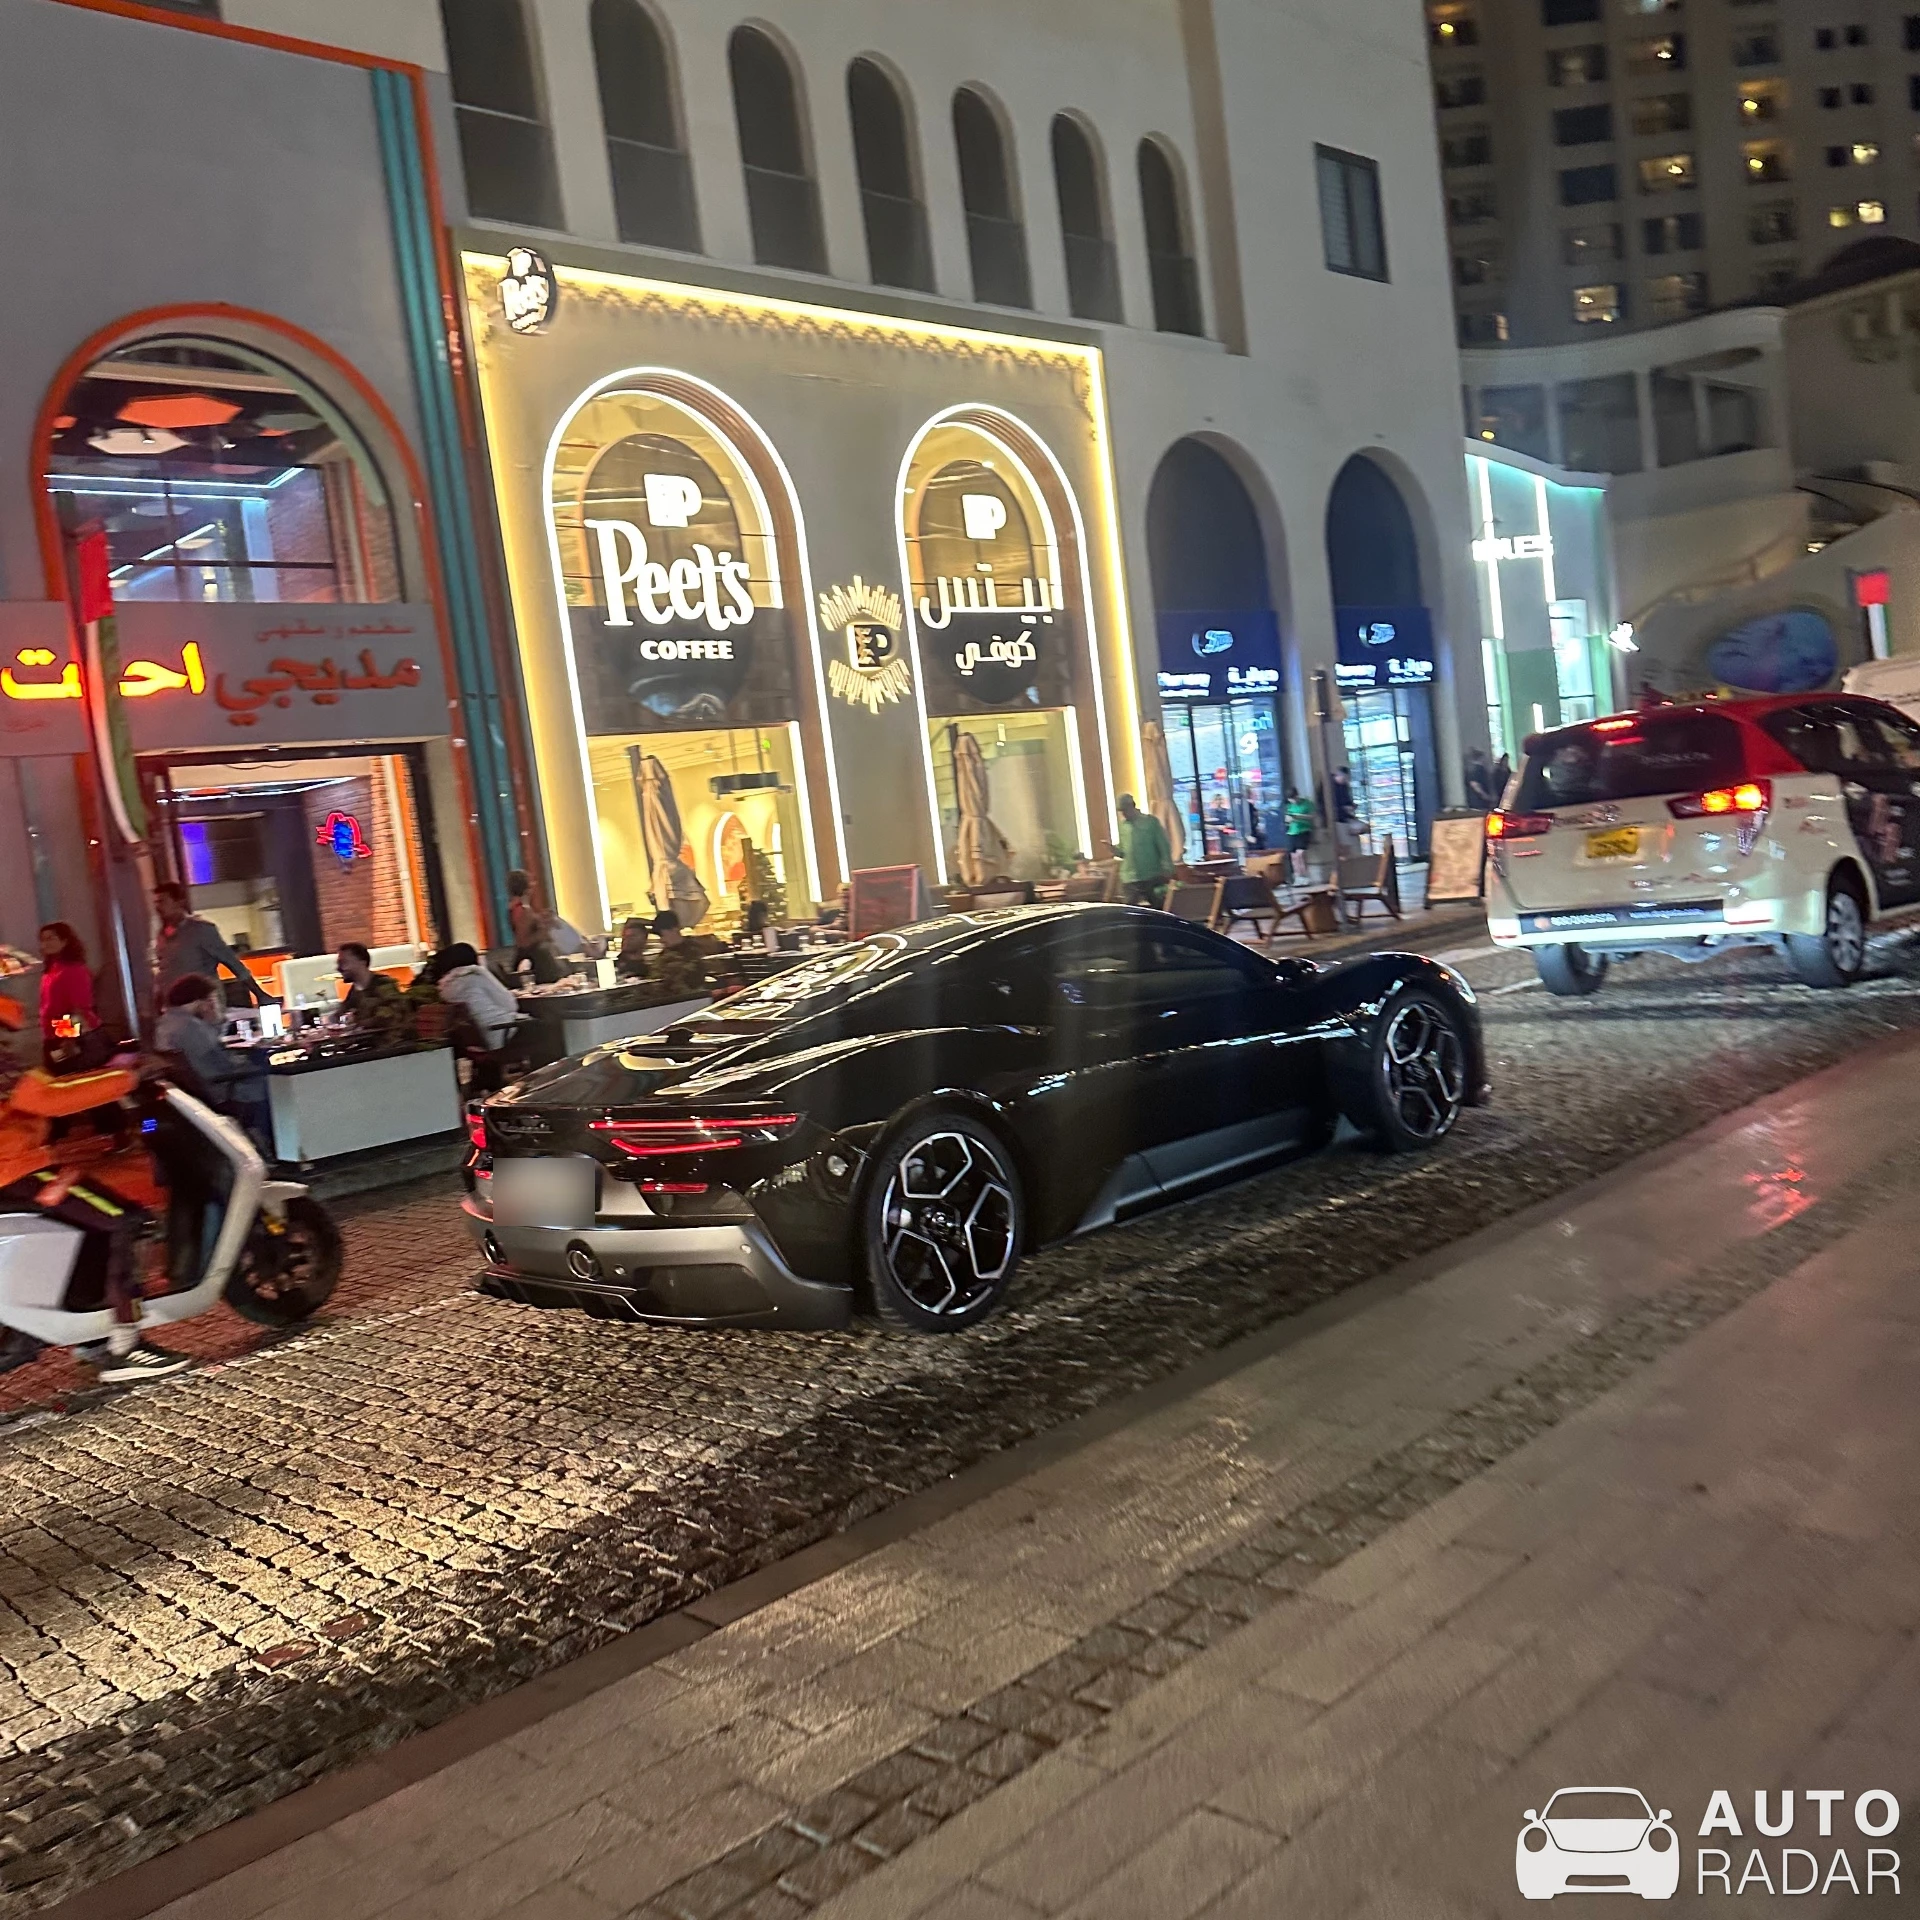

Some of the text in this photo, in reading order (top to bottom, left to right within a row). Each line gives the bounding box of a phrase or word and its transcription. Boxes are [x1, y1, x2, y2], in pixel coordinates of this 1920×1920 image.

[584, 519, 755, 631] Peet's
[920, 562, 1054, 629] بيتس
[639, 640, 735, 660] COFFEE
[955, 630, 1037, 675] كوفي
